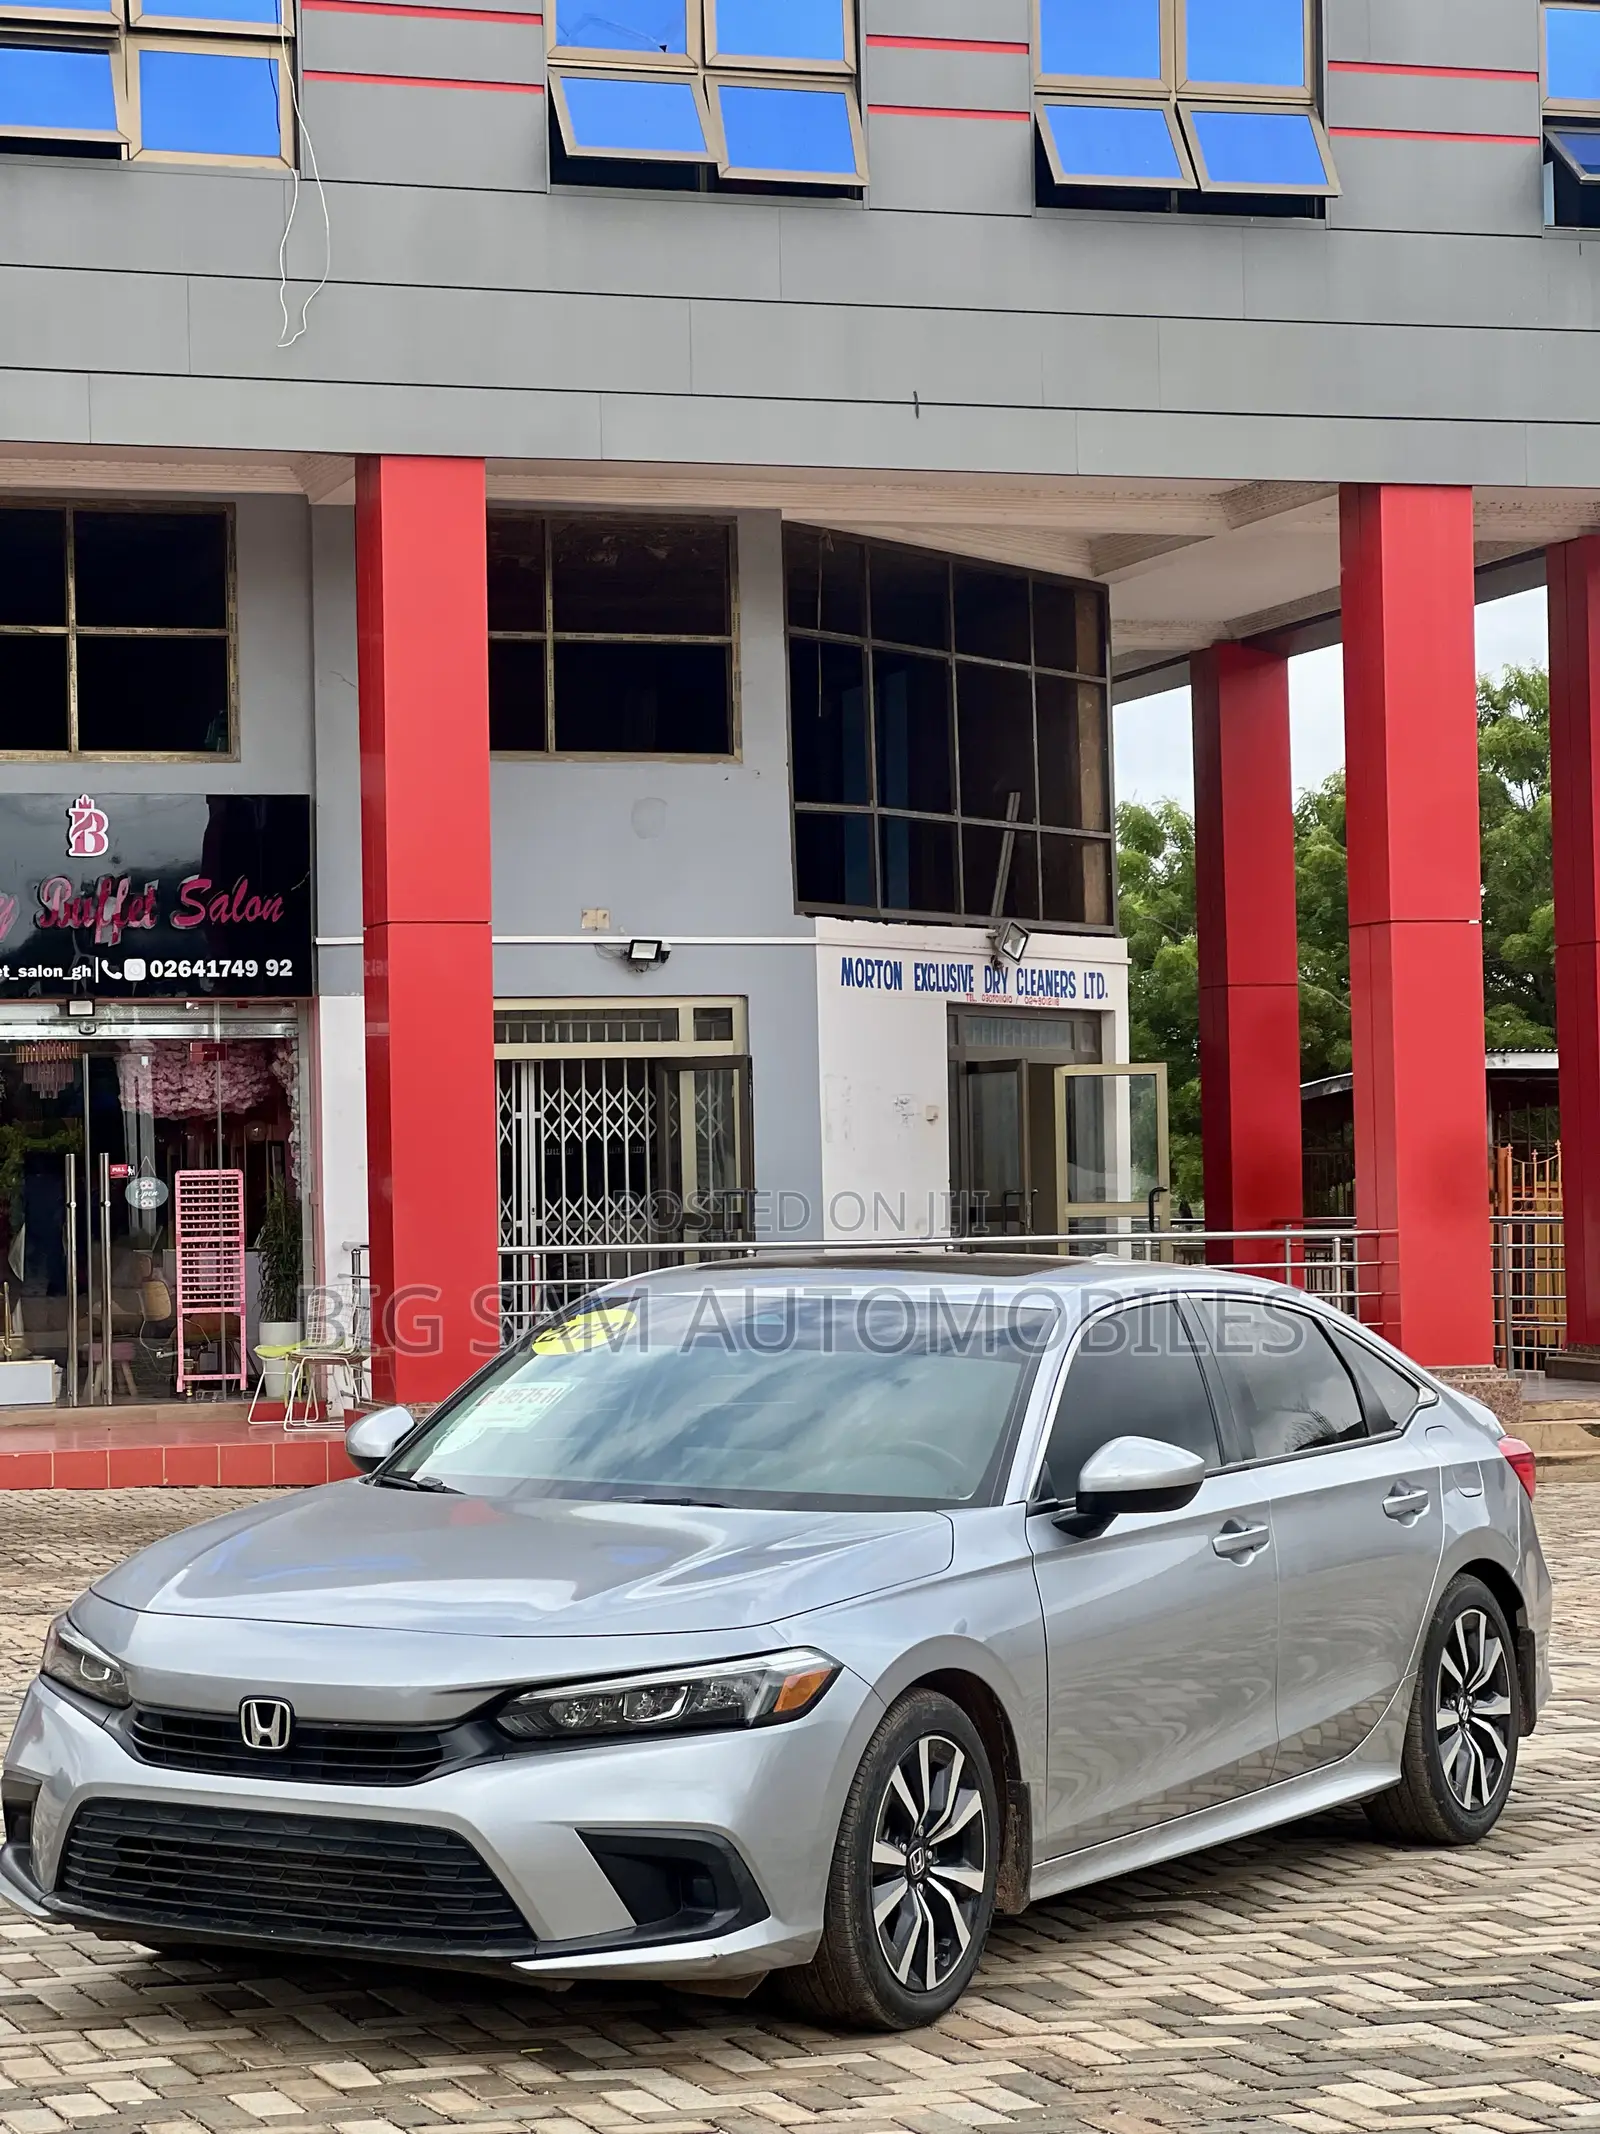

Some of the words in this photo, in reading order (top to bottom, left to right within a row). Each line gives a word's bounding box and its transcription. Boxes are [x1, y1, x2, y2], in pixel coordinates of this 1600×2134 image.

[35, 875, 158, 946] Buffet
[171, 874, 284, 929] Salon
[150, 959, 259, 978] 02641749
[265, 959, 293, 977] 92
[840, 957, 903, 991] MORTON
[914, 962, 974, 993] EXCLUSIVE
[984, 965, 1009, 994] DRY
[1016, 967, 1077, 999] CLEANERS
[1083, 971, 1109, 1000] LTD.
[135, 1189, 158, 1200] Open
